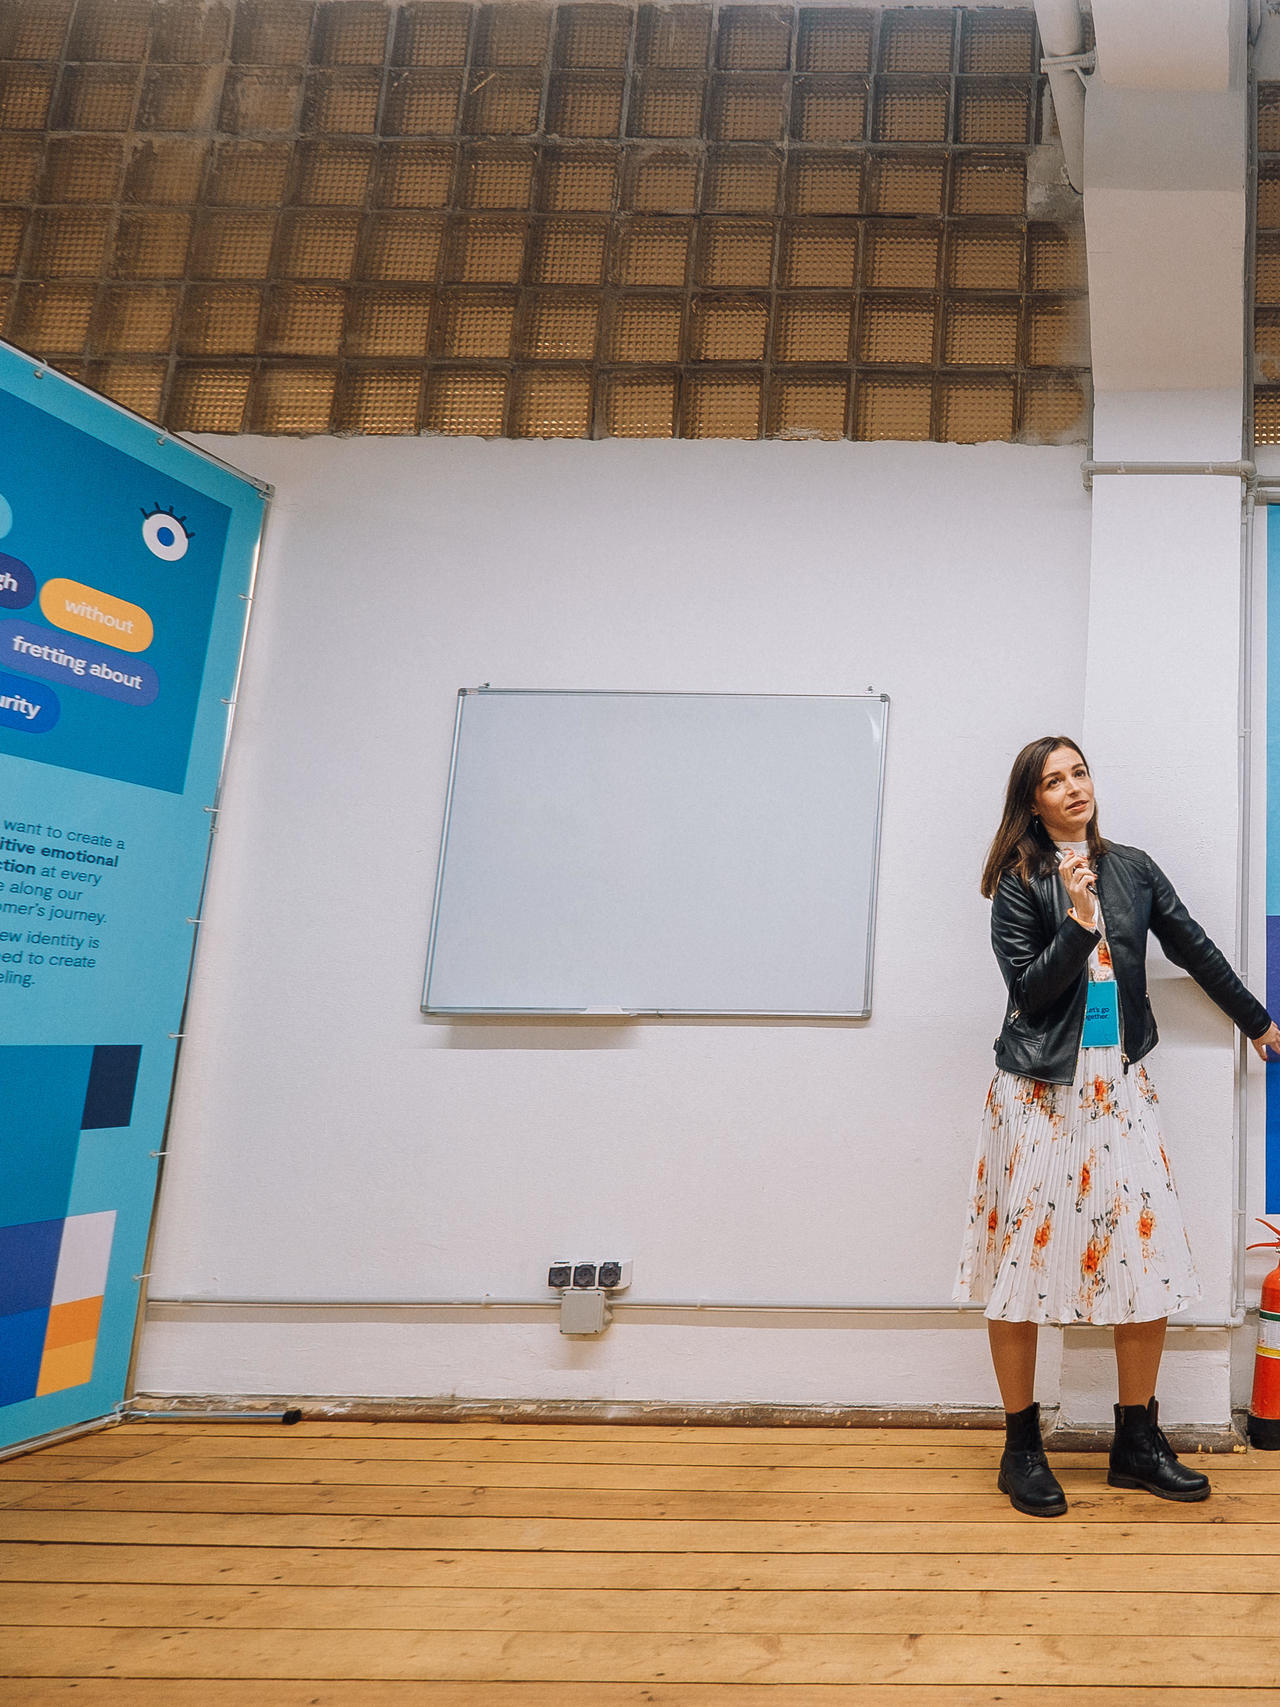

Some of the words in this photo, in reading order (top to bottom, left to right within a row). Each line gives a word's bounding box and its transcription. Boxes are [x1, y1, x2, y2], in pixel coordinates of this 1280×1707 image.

[65, 598, 135, 635] without
[12, 635, 87, 676] fretting
[89, 662, 143, 690] about
[4, 820, 42, 836] want
[47, 826, 62, 839] to
[67, 831, 112, 848] create
[116, 840, 126, 850] a
[41, 846, 119, 868] emotional
[0, 859, 36, 876] tion
[41, 866, 56, 878] at
[61, 869, 102, 887] every
[9, 880, 53, 901] along
[58, 889, 83, 901] our
[0, 902, 46, 917] mer's
[48, 904, 107, 926] journey.
[27, 930, 84, 951] identity
[88, 936, 100, 949] is
[0, 950, 23, 964] ed
[28, 951, 44, 965] to
[49, 954, 96, 968] create
